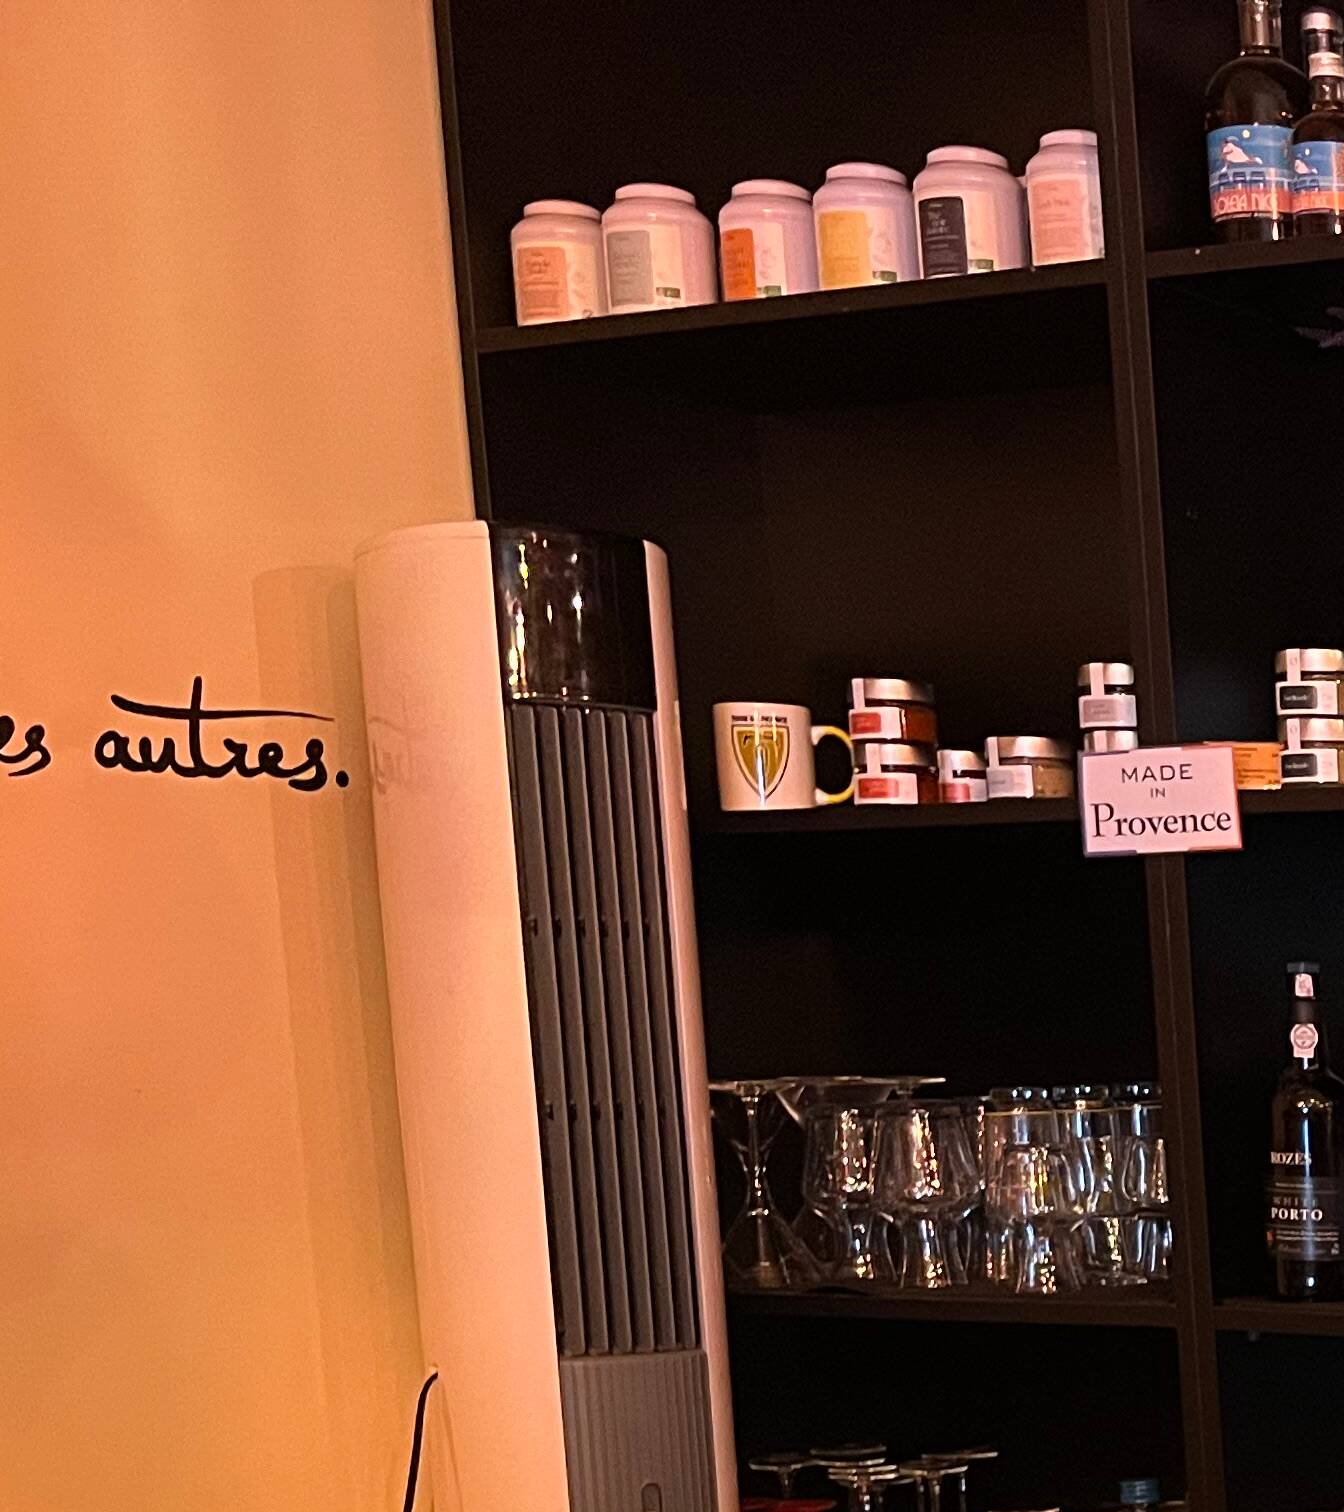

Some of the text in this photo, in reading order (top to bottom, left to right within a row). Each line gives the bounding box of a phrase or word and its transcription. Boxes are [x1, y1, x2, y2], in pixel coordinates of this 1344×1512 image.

[94, 675, 350, 792] autres.
[1120, 763, 1194, 785] MADE
[1149, 786, 1167, 799] IN
[1089, 802, 1233, 839] Provence
[1270, 1207, 1323, 1222] PORTO
